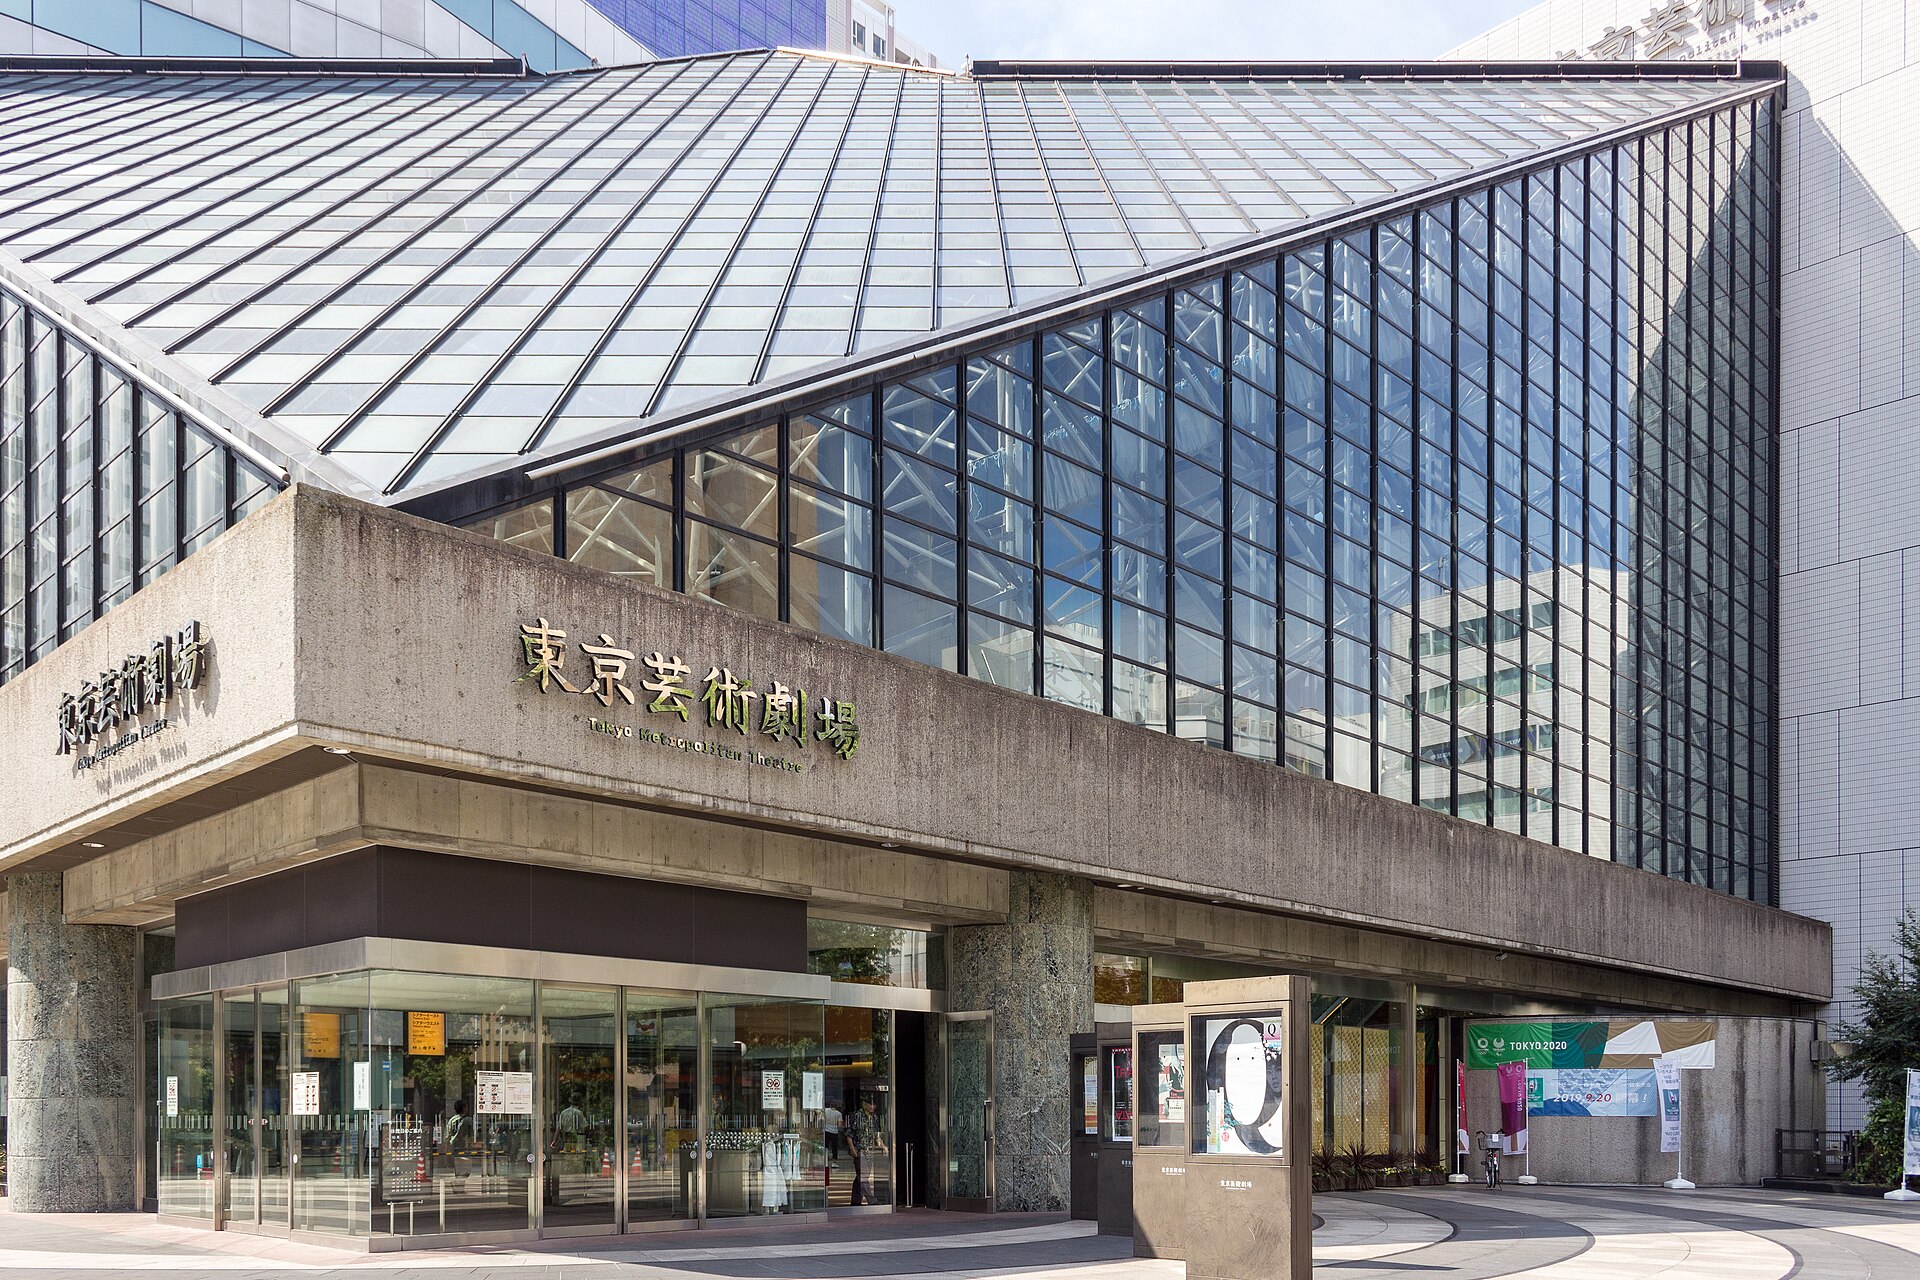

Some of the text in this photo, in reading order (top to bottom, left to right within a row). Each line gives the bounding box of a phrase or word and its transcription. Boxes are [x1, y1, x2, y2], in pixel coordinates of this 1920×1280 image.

[512, 616, 861, 760] 東京芸術劇場
[587, 717, 803, 773] Tokyo Metropolitan Theatre
[1268, 1023, 1277, 1038] Q
[1510, 1041, 1567, 1051] TOKYO 2020
